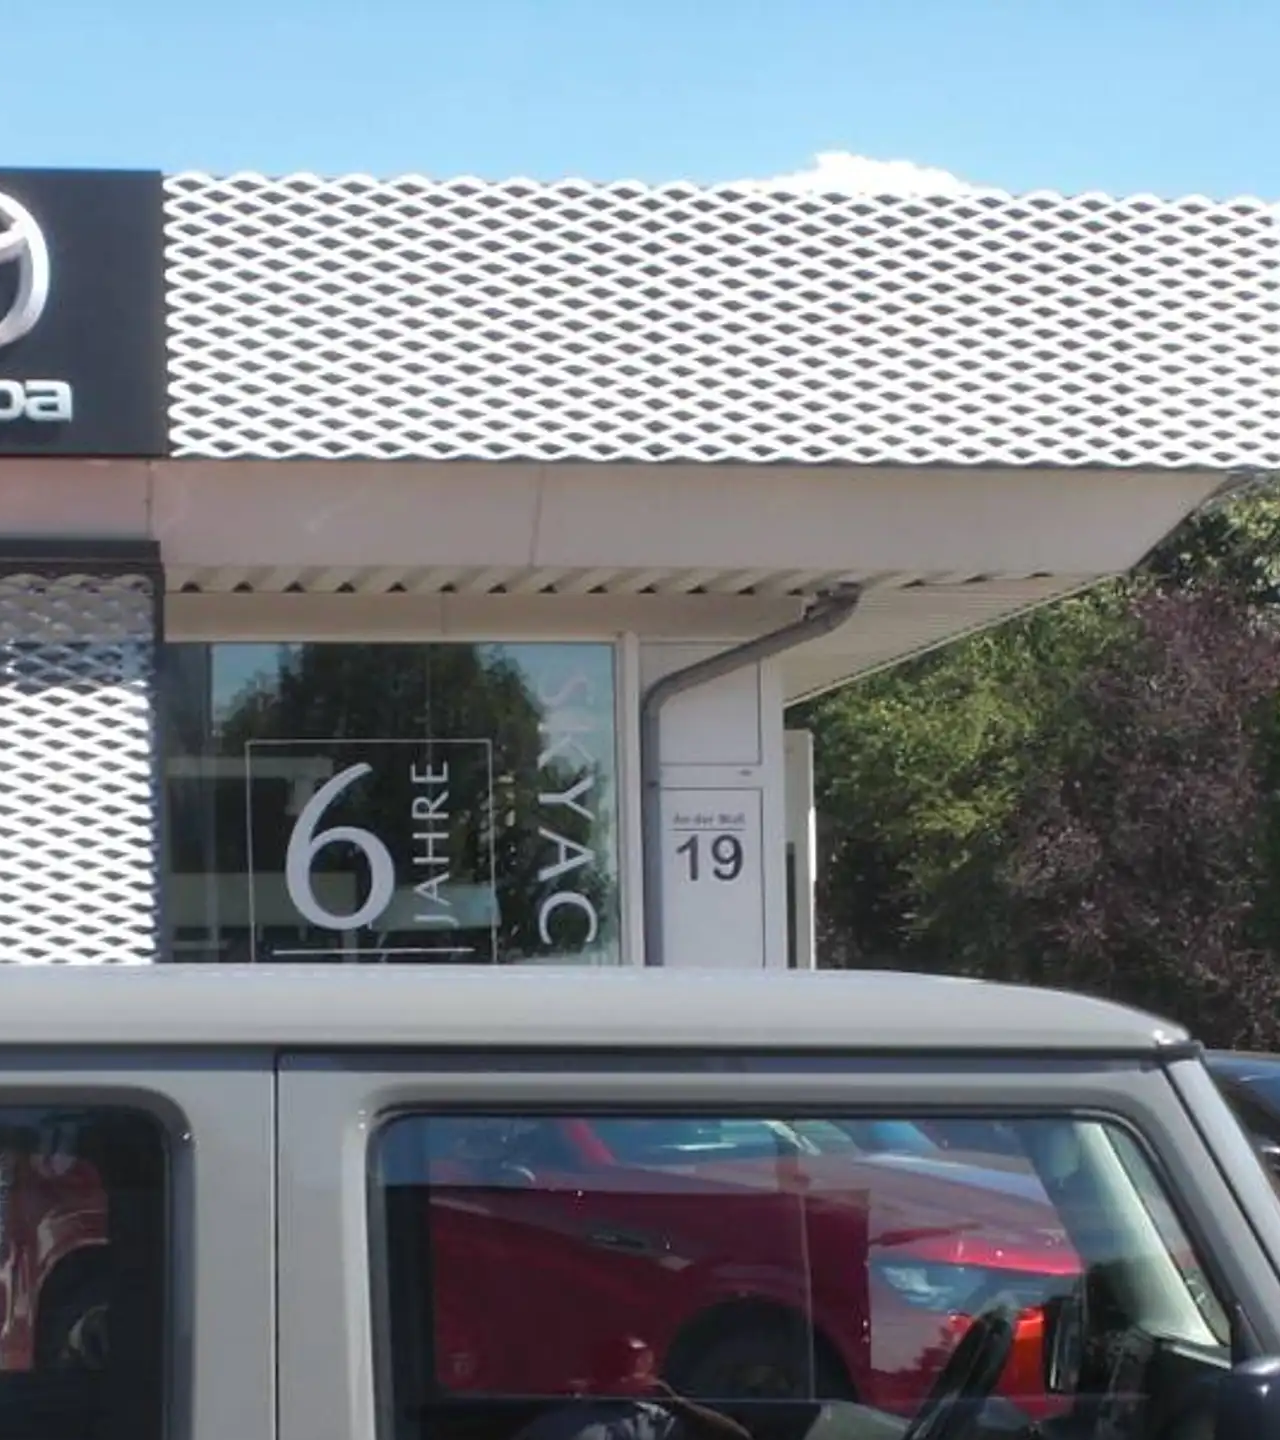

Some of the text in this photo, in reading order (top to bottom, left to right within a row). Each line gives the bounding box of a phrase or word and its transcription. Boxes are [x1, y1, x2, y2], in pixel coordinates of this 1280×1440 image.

[286, 762, 395, 931] 6
[411, 760, 460, 928] JAHRE
[675, 834, 744, 882] 19
